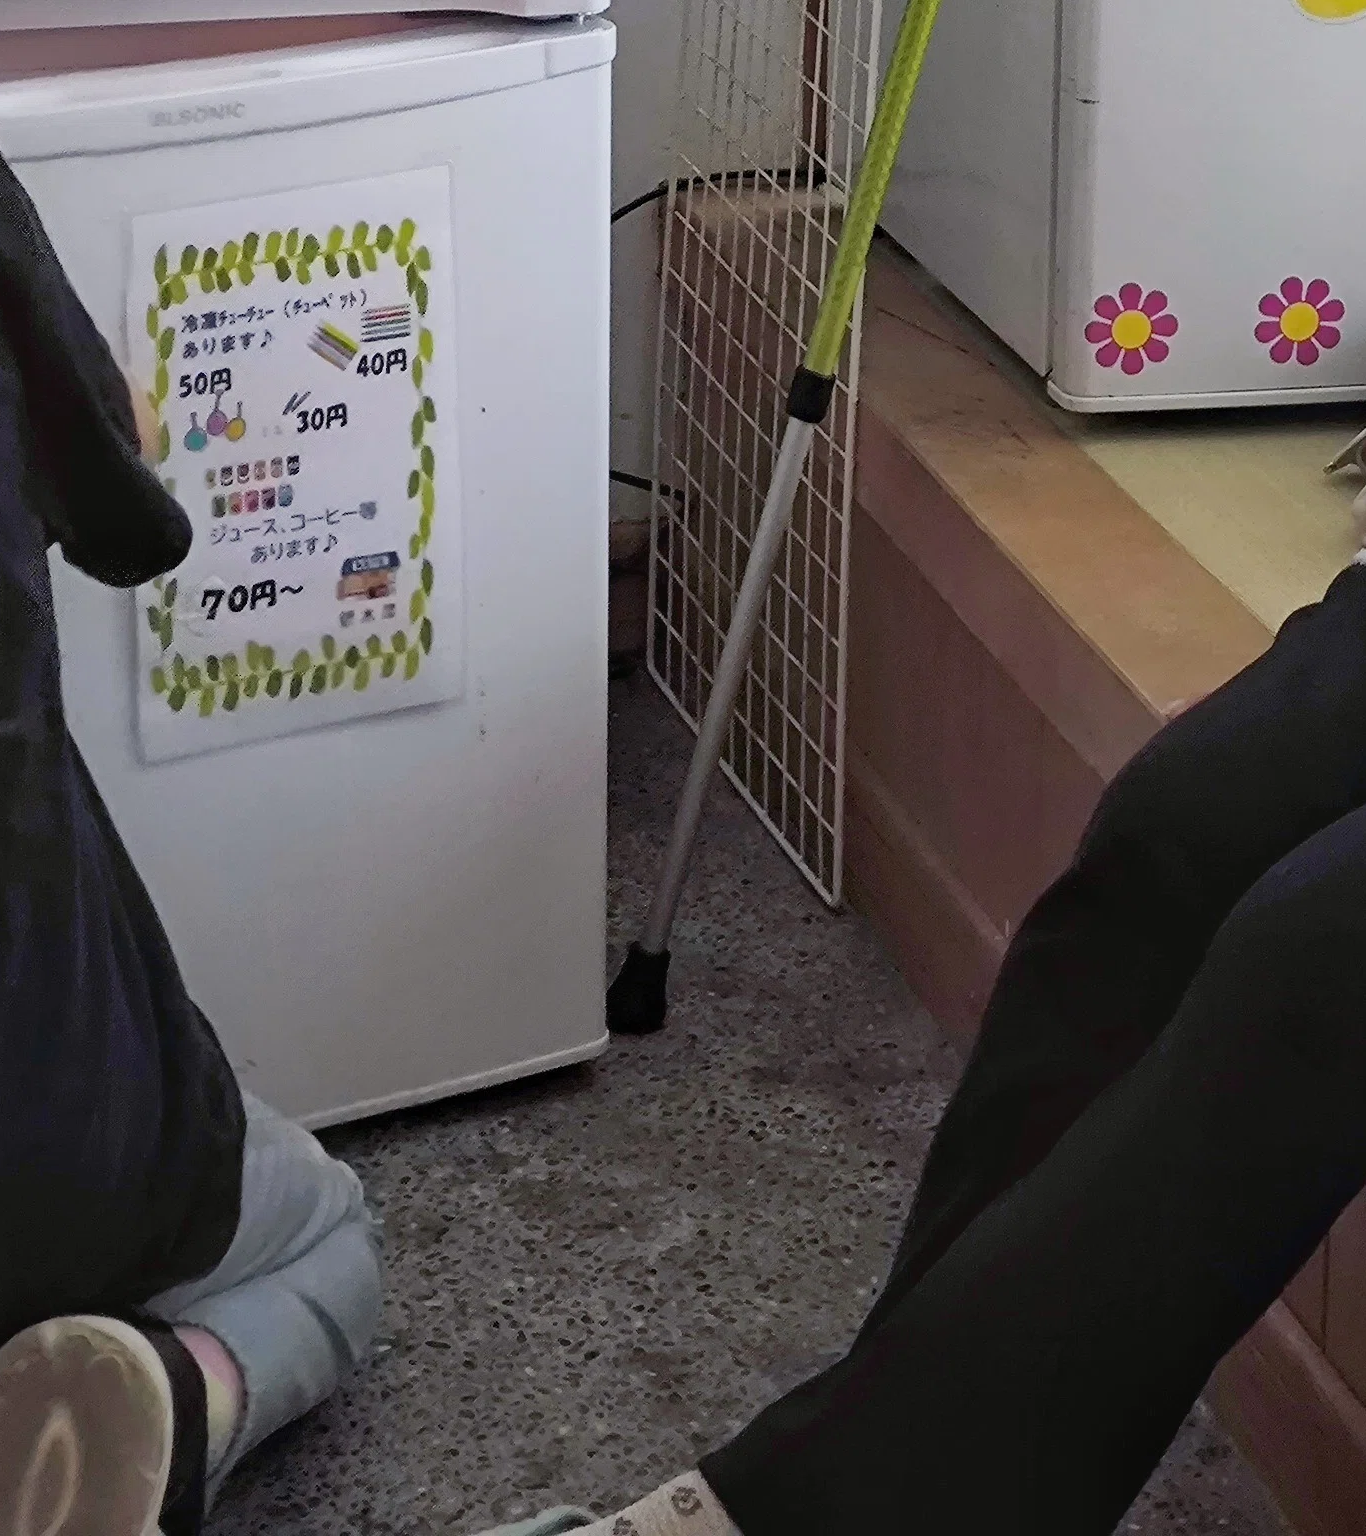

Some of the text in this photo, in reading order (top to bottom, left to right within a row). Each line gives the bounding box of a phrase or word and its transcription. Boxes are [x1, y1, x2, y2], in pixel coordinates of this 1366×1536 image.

[356, 347, 408, 378] 40円
[179, 367, 232, 398] 50円
[296, 402, 348, 434] 30円
